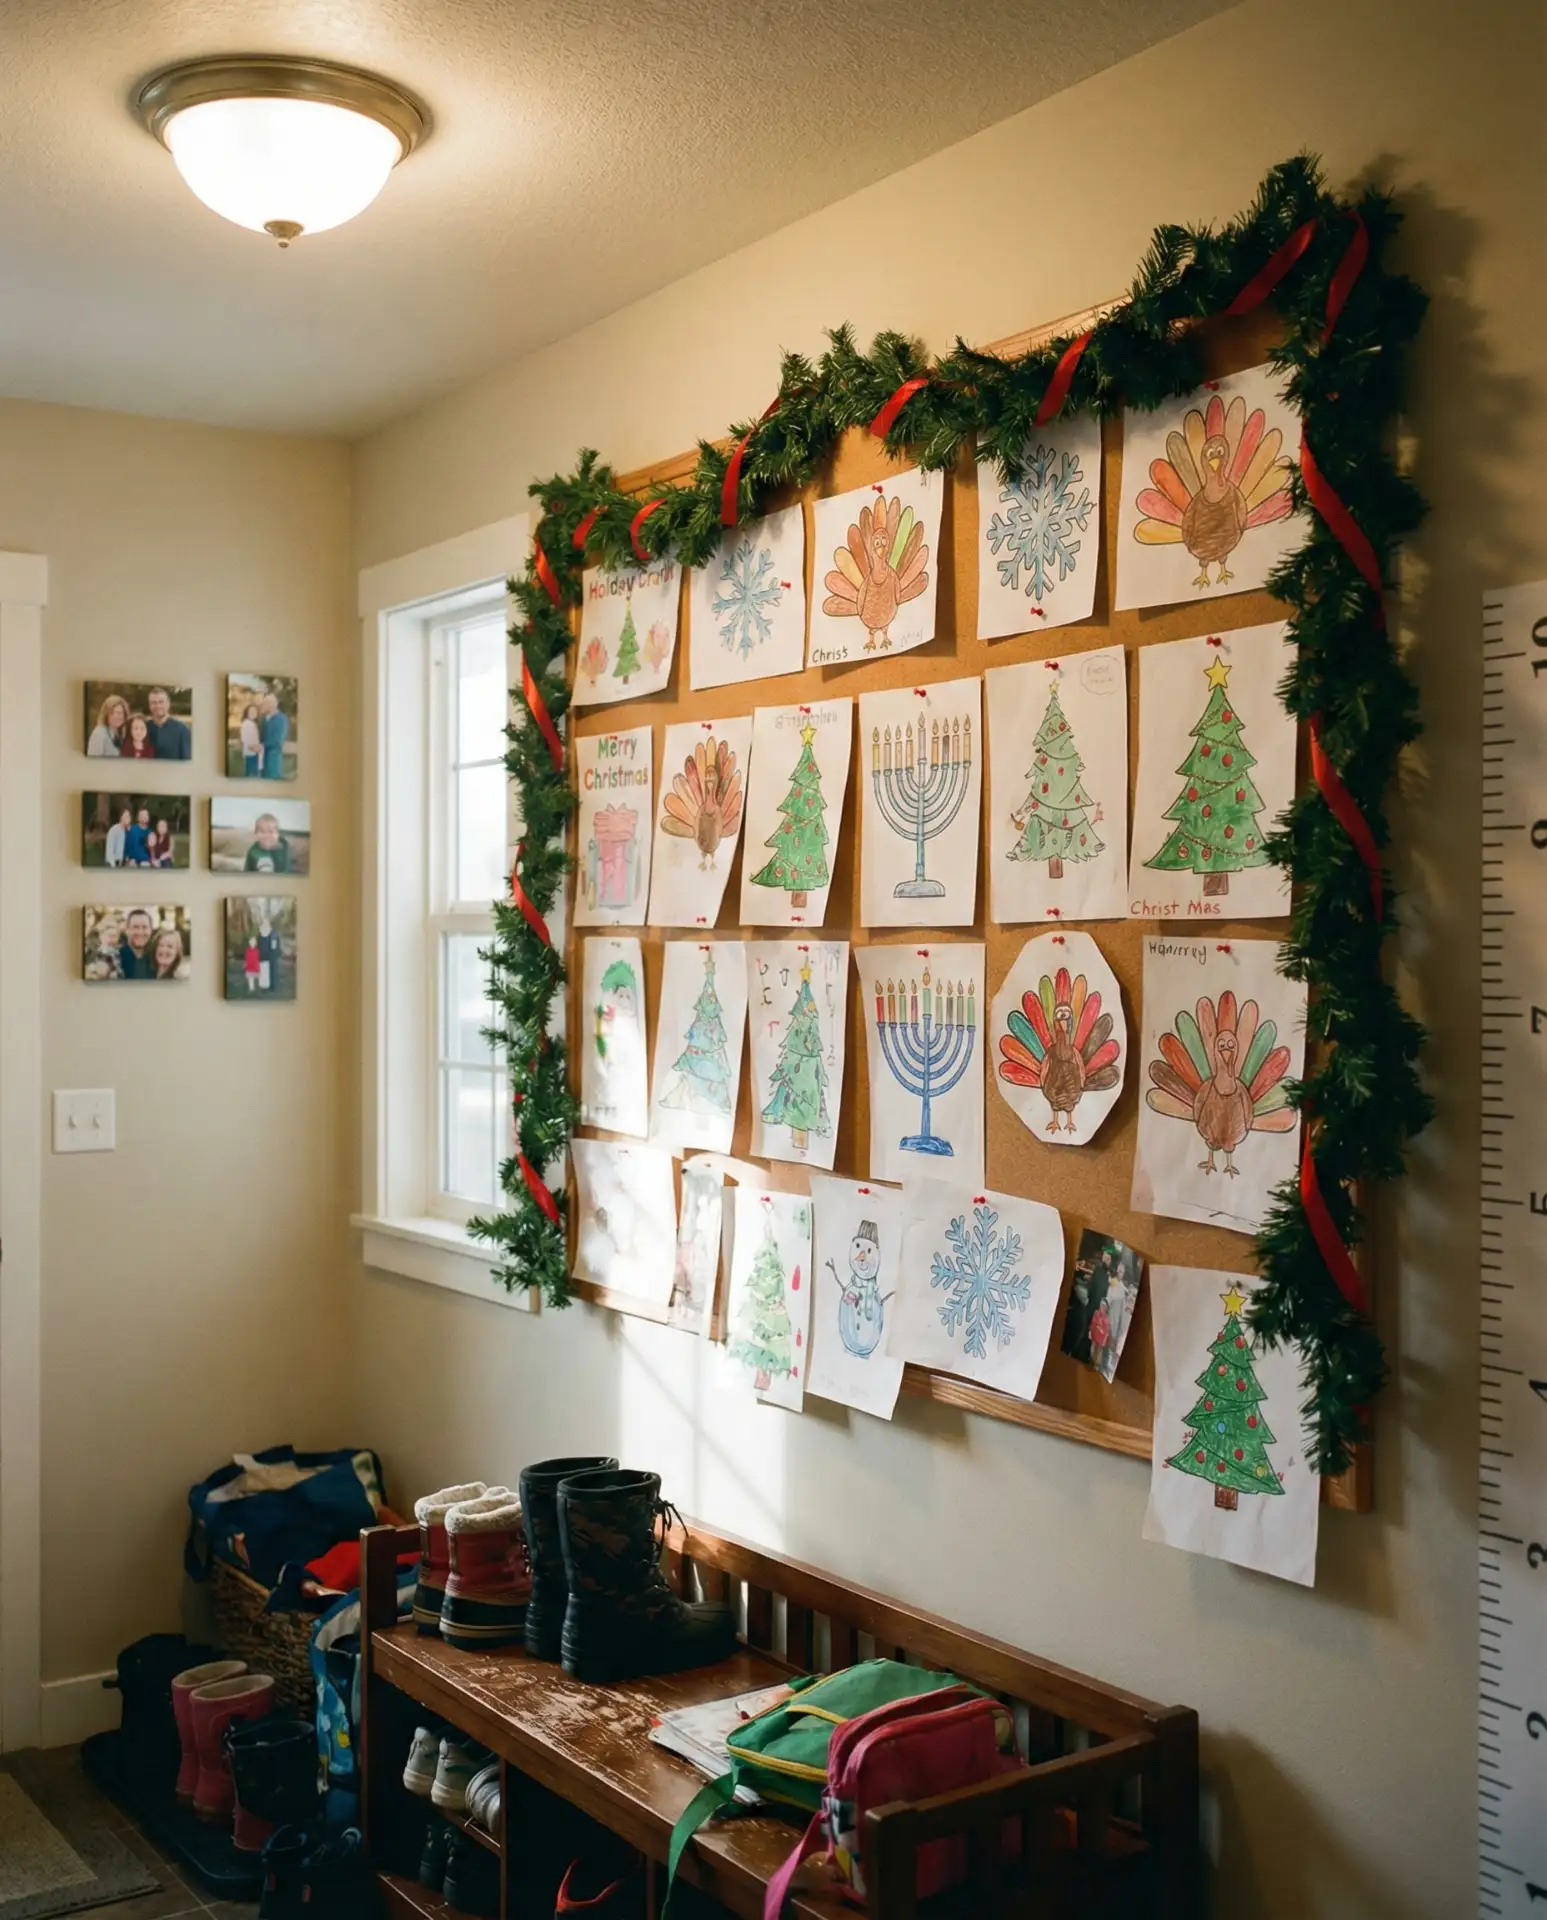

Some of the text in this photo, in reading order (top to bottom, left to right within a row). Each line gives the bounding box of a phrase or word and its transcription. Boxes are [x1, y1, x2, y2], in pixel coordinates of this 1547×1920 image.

[598, 737, 637, 759] Merry
[584, 764, 648, 790] Christmas
[1130, 899, 1180, 916] Christ
